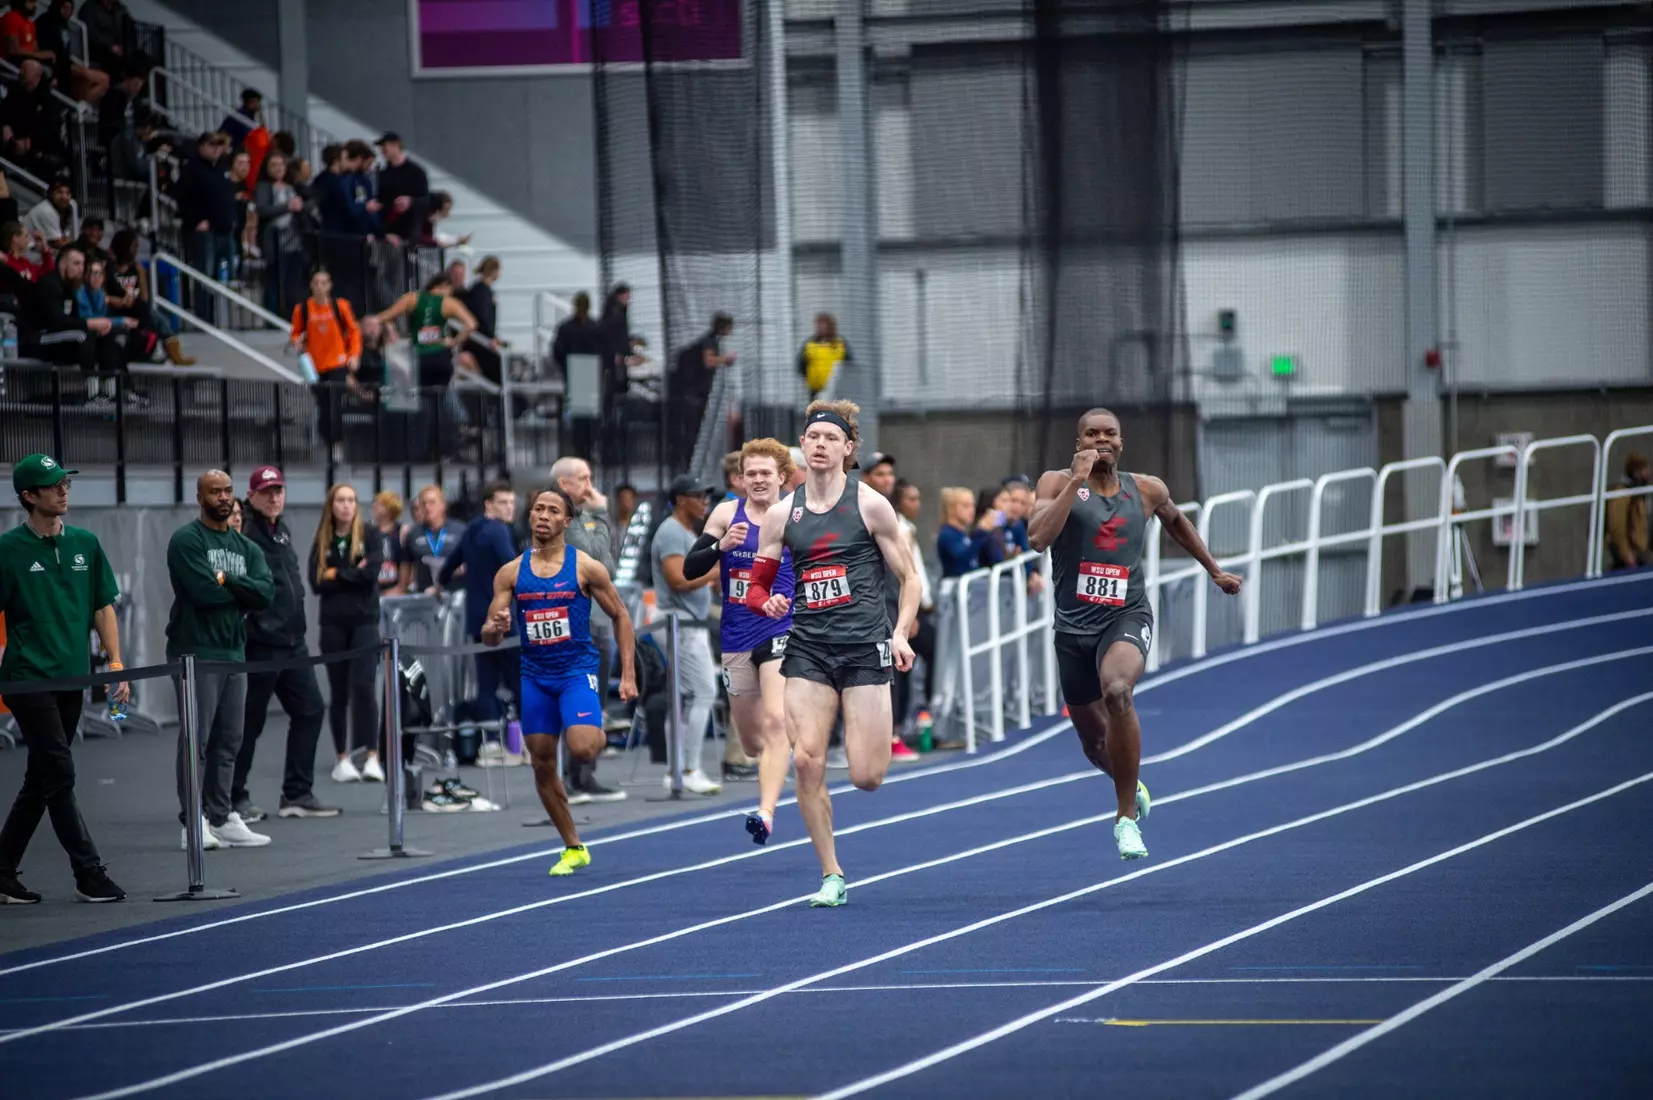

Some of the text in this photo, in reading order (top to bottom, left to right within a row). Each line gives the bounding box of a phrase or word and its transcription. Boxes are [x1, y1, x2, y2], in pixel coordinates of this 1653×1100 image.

[811, 579, 842, 600] 879
[1086, 576, 1118, 597] 881
[533, 621, 562, 639] 166
